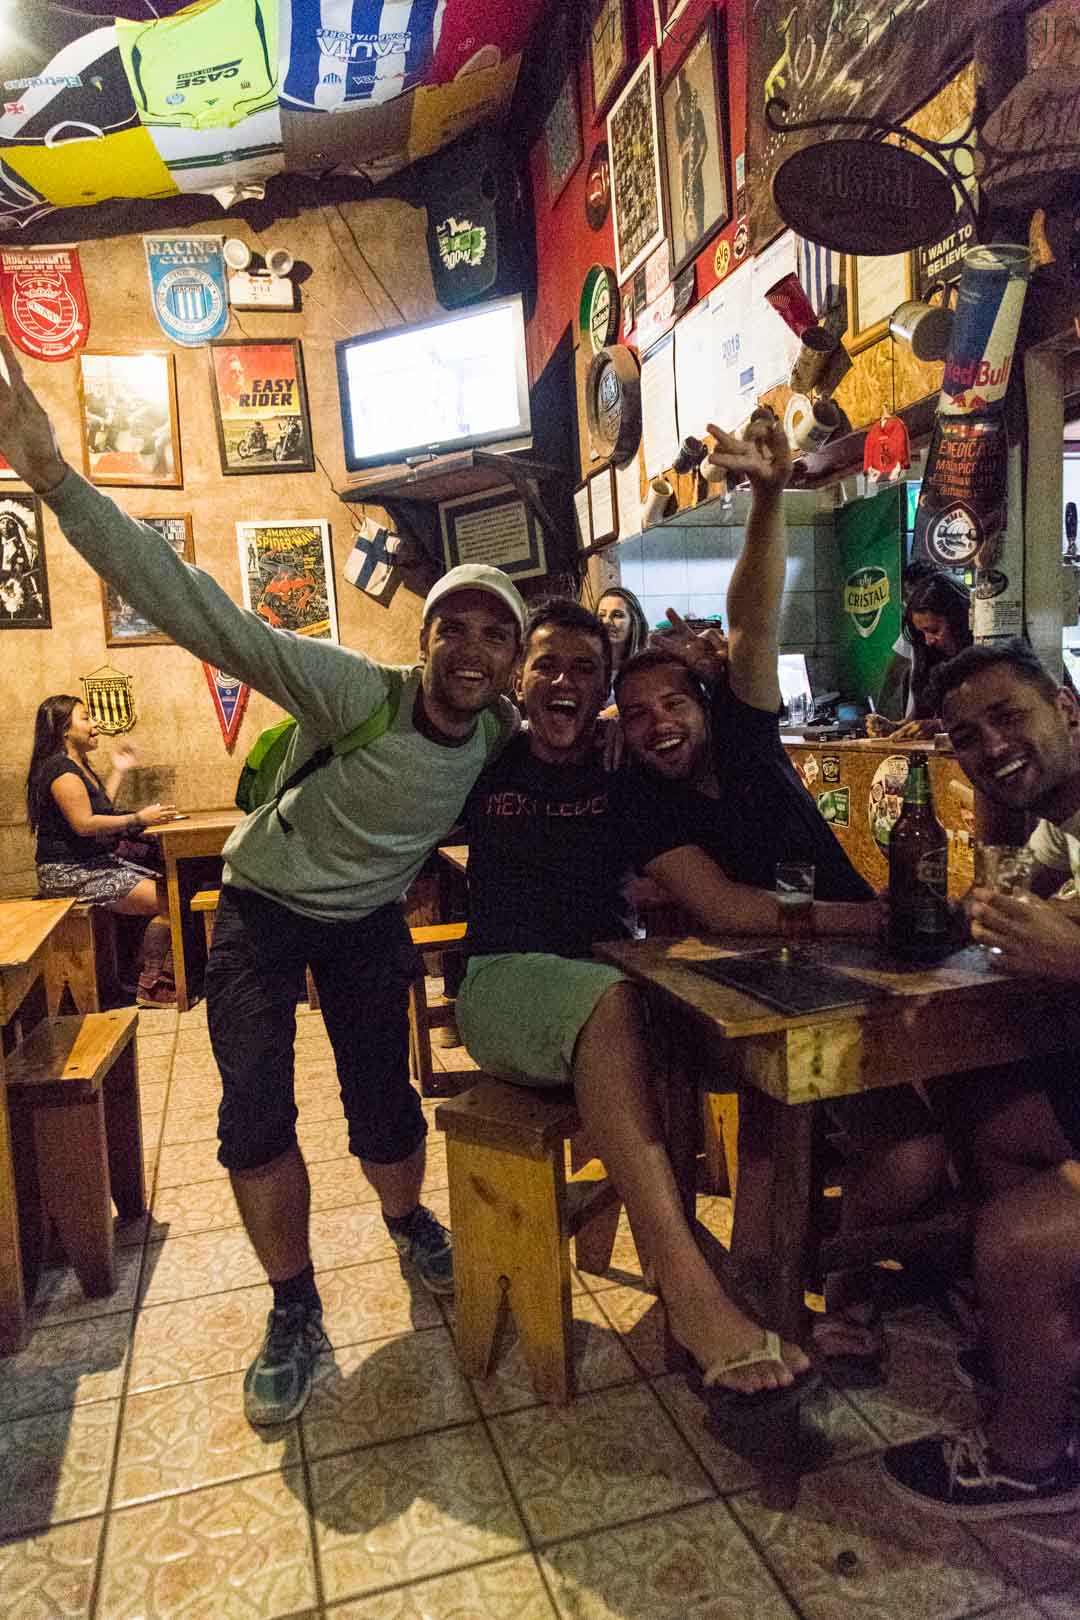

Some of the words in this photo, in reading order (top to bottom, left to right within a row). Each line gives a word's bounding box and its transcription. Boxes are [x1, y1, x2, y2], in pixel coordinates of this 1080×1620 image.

[316, 35, 412, 59] PAUTA
[3, 73, 82, 90] Eletrobras
[176, 66, 240, 90] CASE
[148, 240, 217, 256] RACING
[928, 234, 956, 261] WANT
[958, 224, 973, 242] TO
[160, 255, 210, 265] CLUB
[927, 243, 968, 277] BELIEVE
[945, 358, 975, 384] Red
[975, 354, 1012, 386] Bull
[252, 378, 296, 393] EASY
[239, 393, 292, 407] RIDER
[848, 586, 887, 608] CRISTAL
